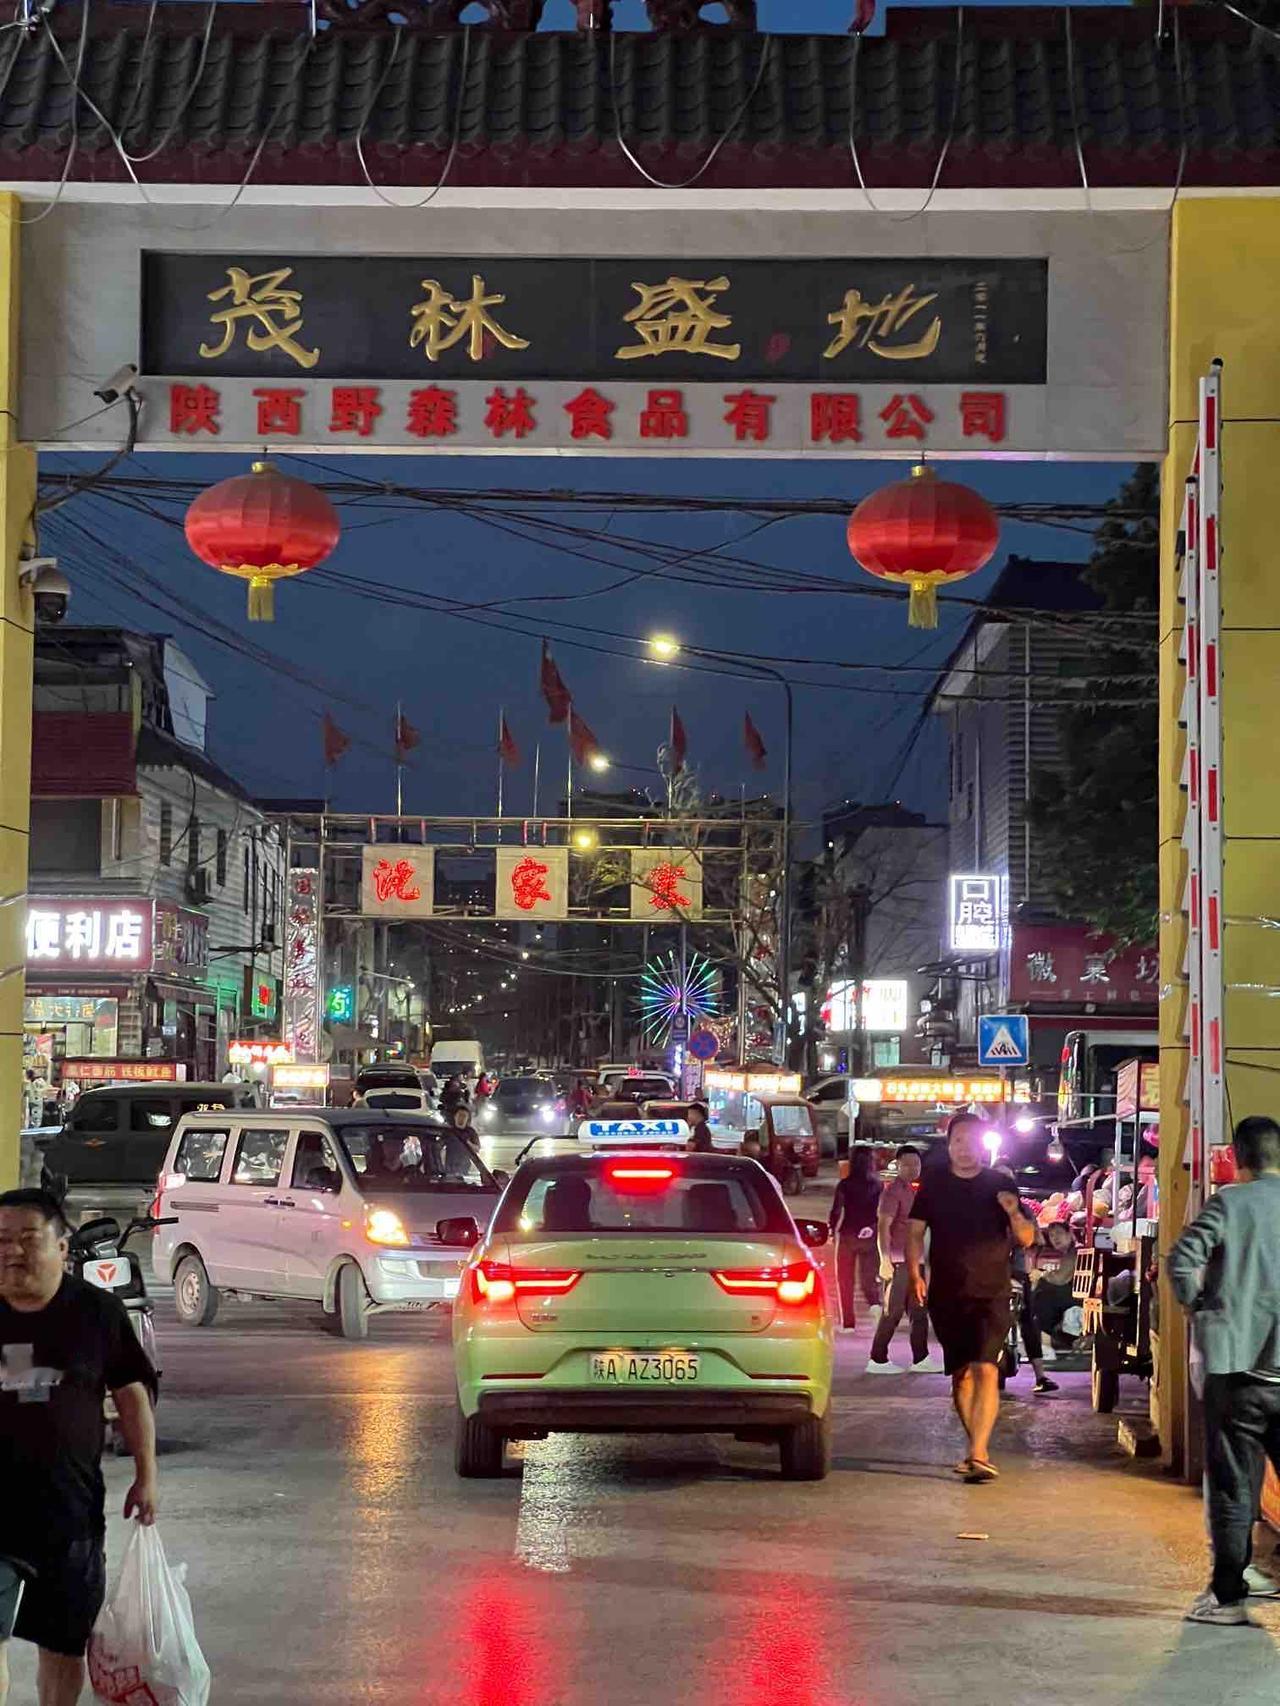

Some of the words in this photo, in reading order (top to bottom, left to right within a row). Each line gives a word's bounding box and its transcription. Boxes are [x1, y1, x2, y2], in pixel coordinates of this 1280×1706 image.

[199, 266, 940, 370] 茂林盛地
[170, 376, 1008, 444] 陕西野森林食品有限公司
[957, 880, 995, 925] 口腔
[25, 909, 143, 960] 便利店
[595, 1121, 674, 1131] TAXI
[593, 1358, 617, 1380] 陕A
[628, 1358, 698, 1380] AZ3065
